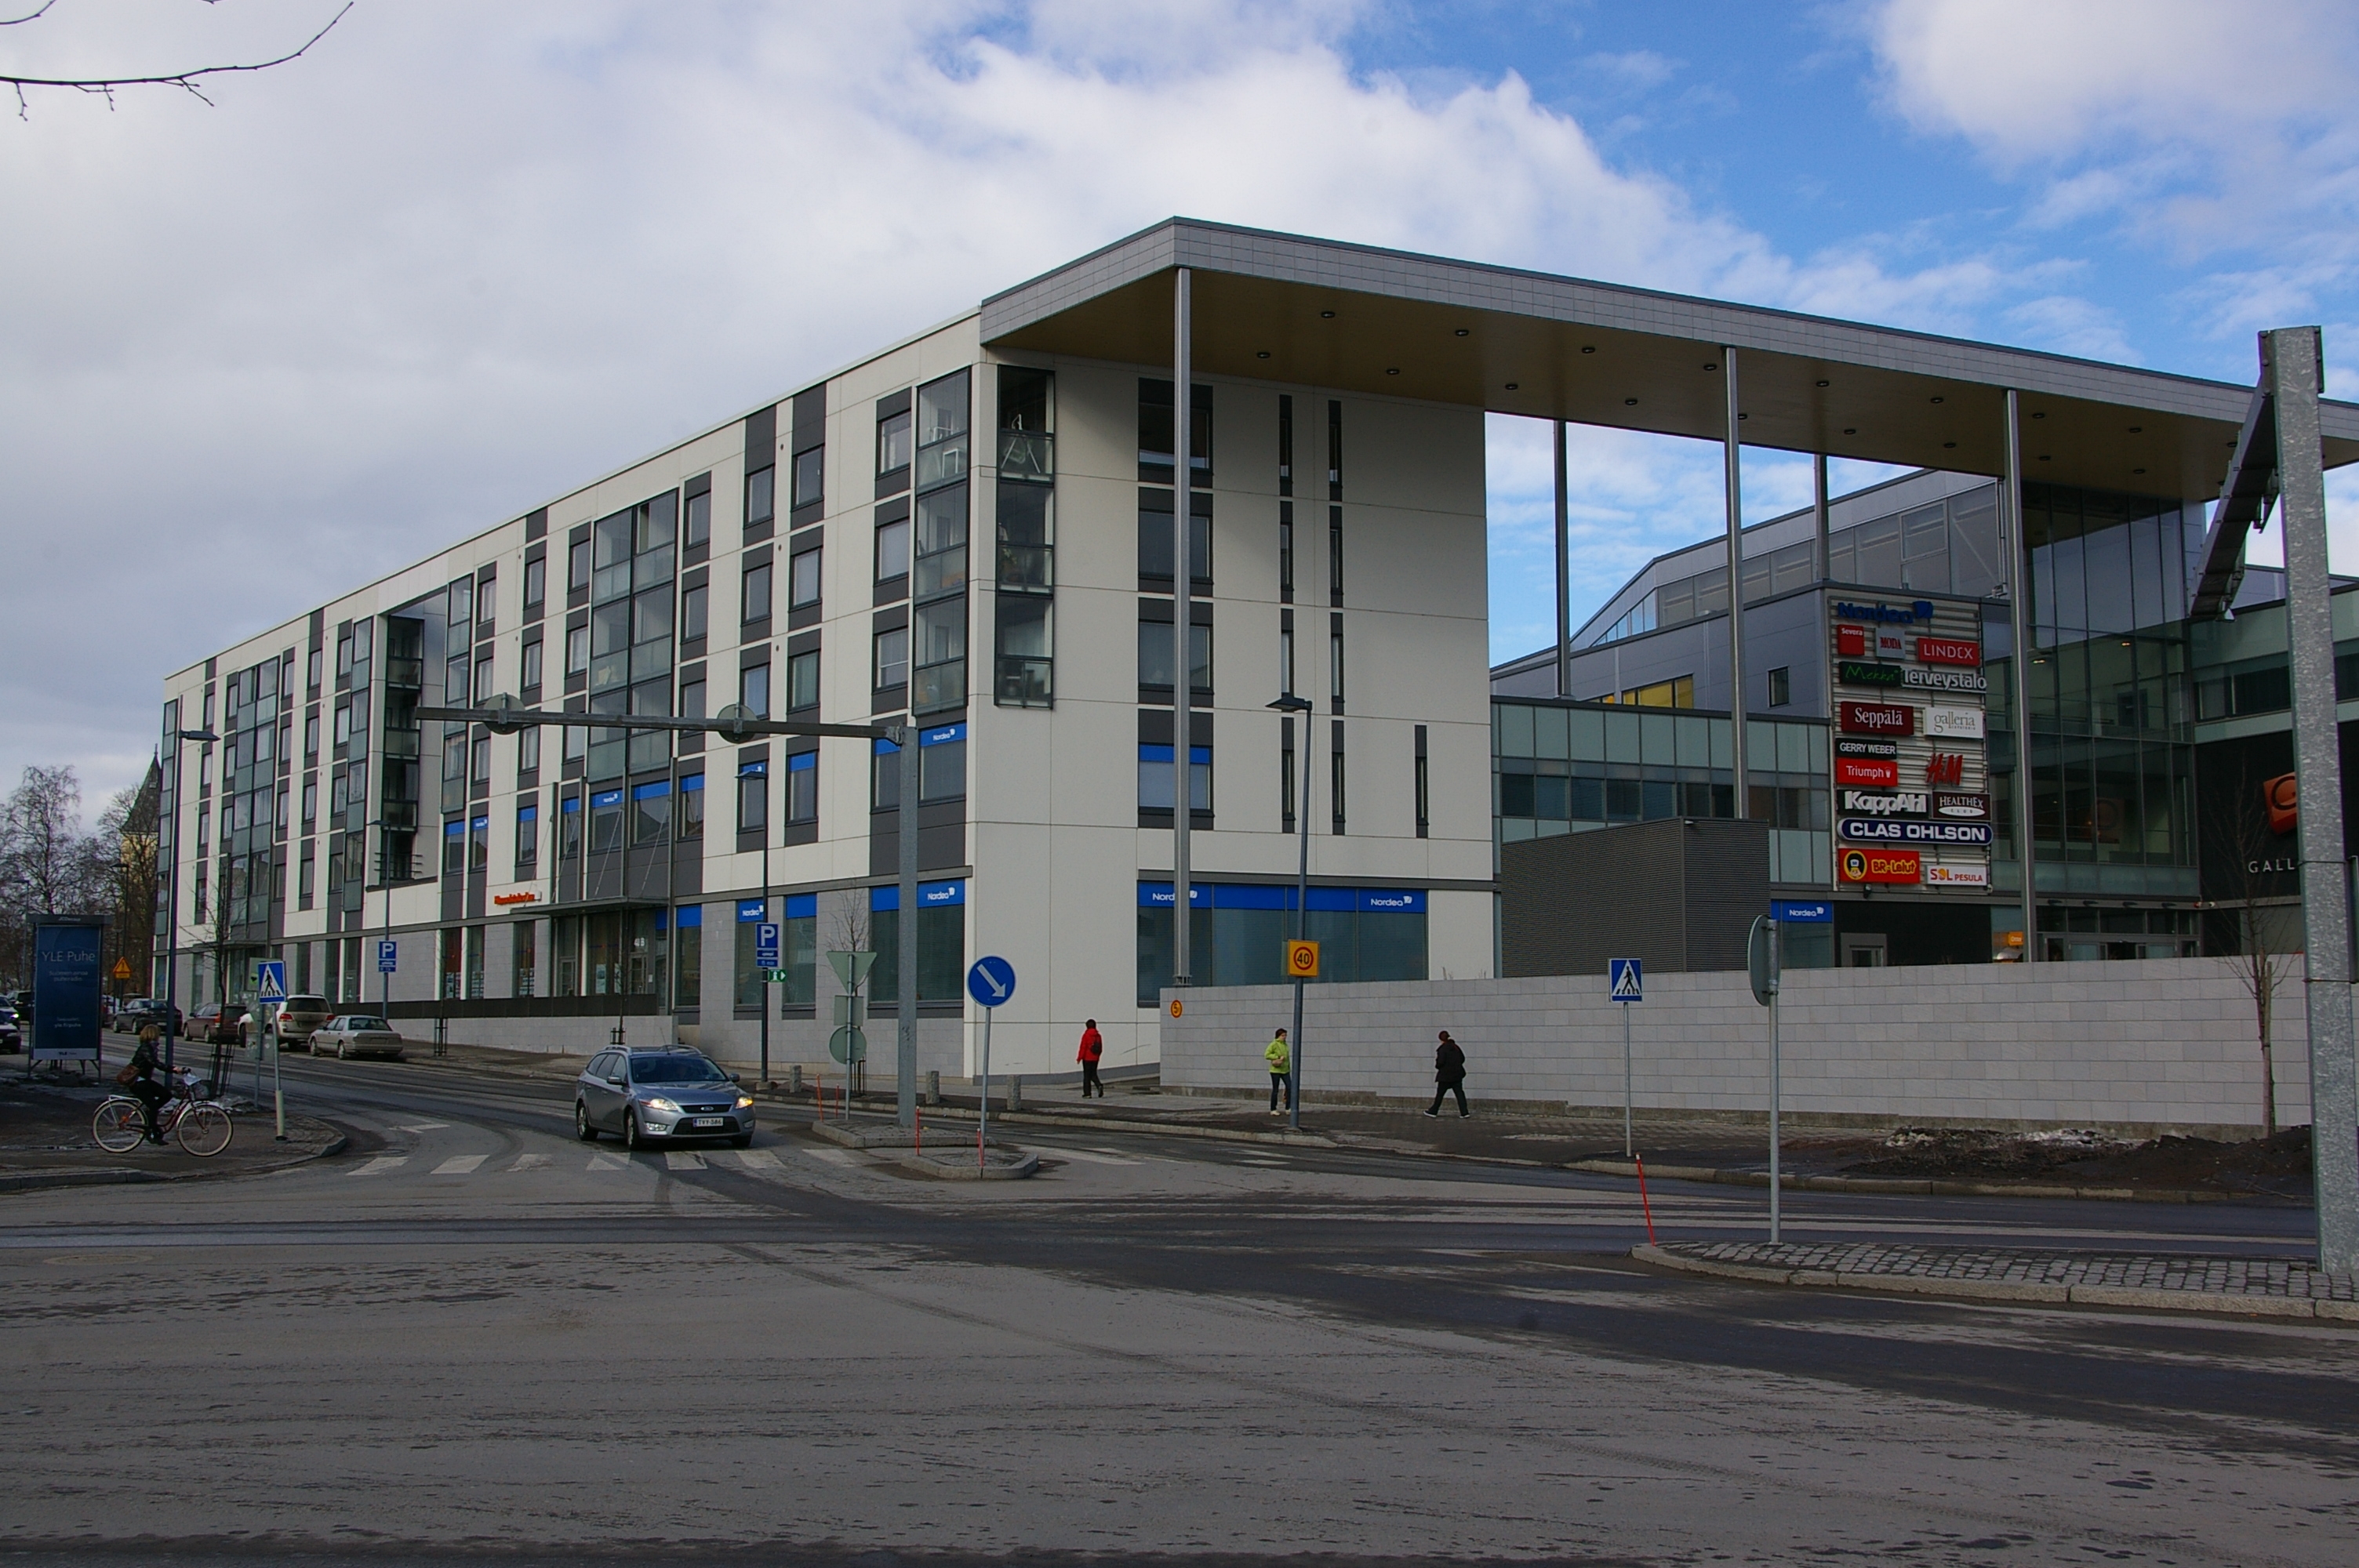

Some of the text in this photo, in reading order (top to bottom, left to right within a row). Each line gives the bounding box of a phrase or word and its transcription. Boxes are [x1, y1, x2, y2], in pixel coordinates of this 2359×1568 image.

[1837, 601, 1914, 624] Nordea
[1841, 627, 1863, 637] Severa
[1880, 637, 1903, 650] MODA
[1924, 644, 1973, 660] LINDEX
[1903, 669, 1987, 691] Terveystalo
[1855, 707, 1903, 728] Seppälä
[1934, 711, 1976, 734] galleria
[932, 732, 951, 741] Nordea
[1840, 742, 1896, 754] GERRY WEBER
[1846, 765, 1884, 779] Triumph
[1926, 753, 1963, 786] H&M
[1845, 790, 1927, 815] KappAhl
[1850, 822, 1986, 840] CLAS OHLSON
[2248, 858, 2295, 873] GALL
[1930, 868, 1983, 882] SOL PESULA
[927, 891, 950, 901] Nordea
[1152, 892, 1175, 902] Nord
[1370, 898, 1403, 906] Nordea
[742, 908, 759, 916] Nordea
[1789, 909, 1817, 917] Nordea
[761, 926, 776, 946] P
[42, 950, 95, 962] YLE Puhe
[382, 942, 394, 958] P
[1297, 953, 1310, 965] 40
